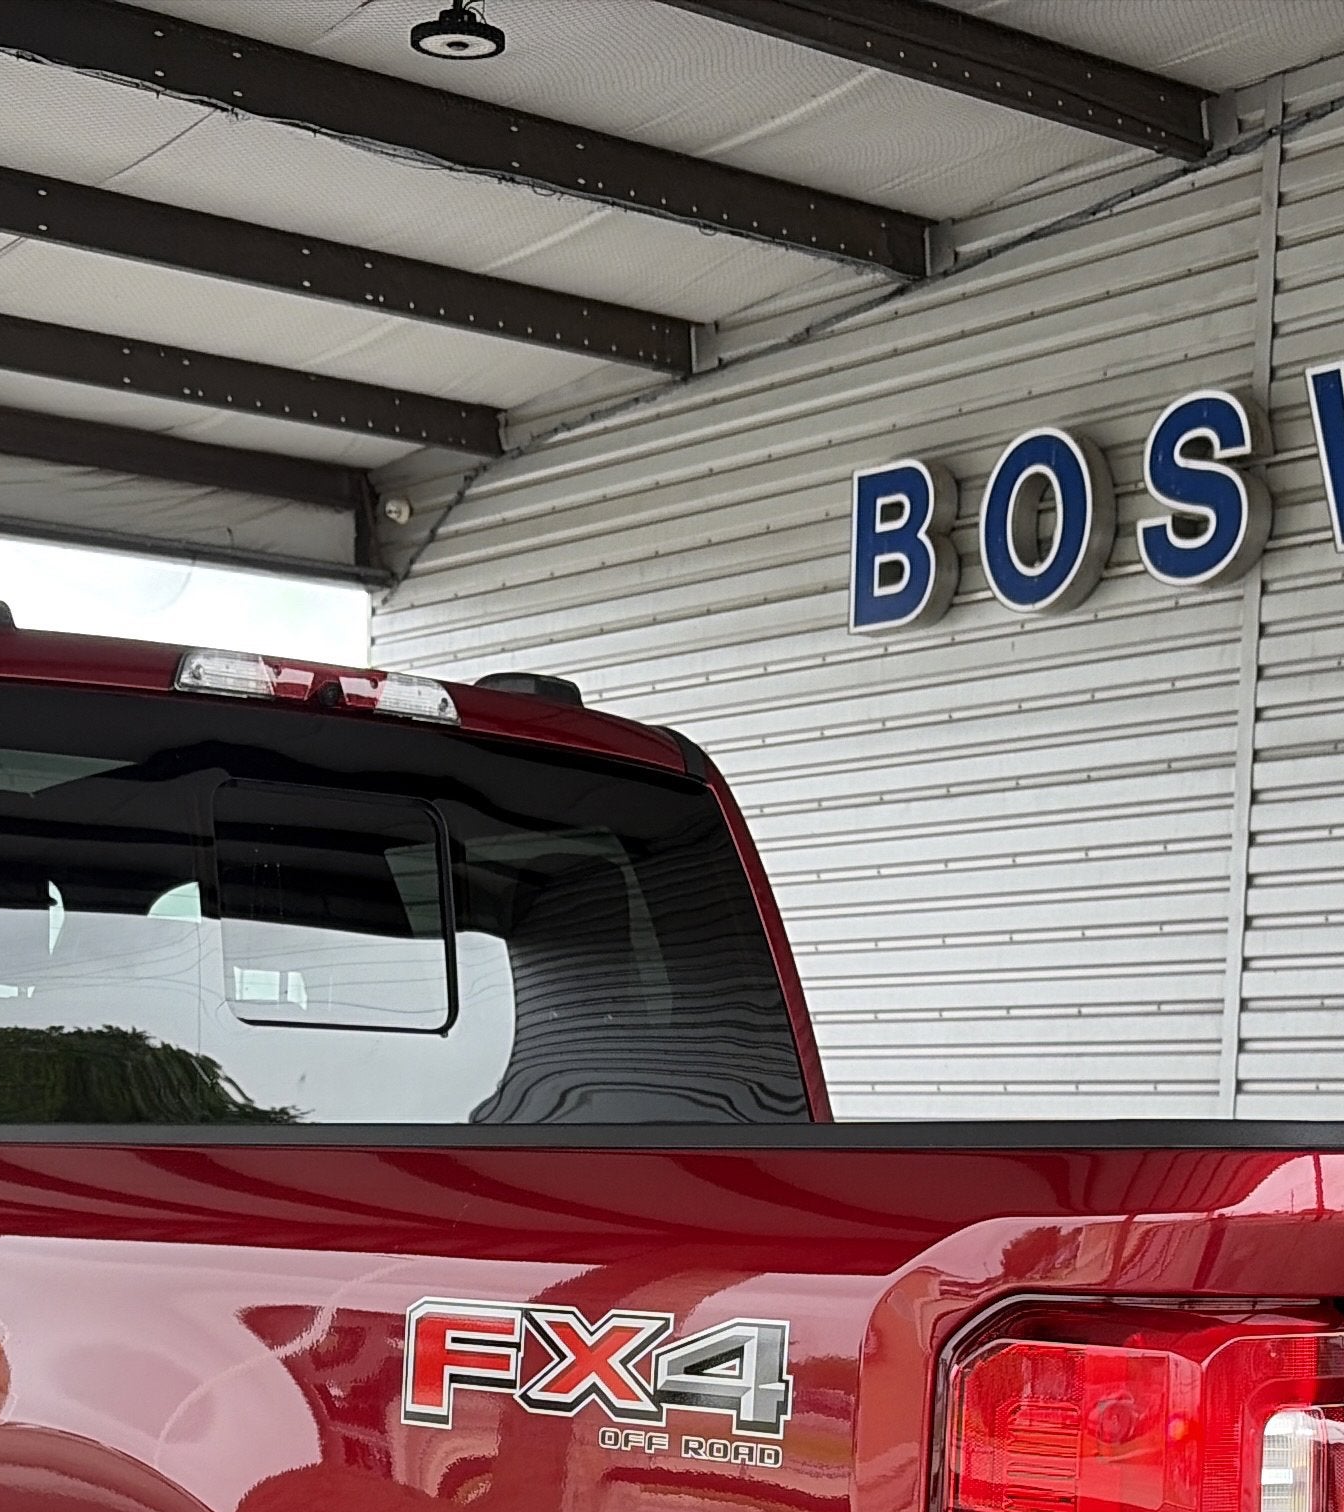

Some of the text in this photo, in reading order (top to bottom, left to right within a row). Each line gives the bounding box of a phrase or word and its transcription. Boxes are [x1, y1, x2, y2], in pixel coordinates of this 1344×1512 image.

[401, 1296, 794, 1440] FX4
[598, 1426, 783, 1469] OFF ROAD
